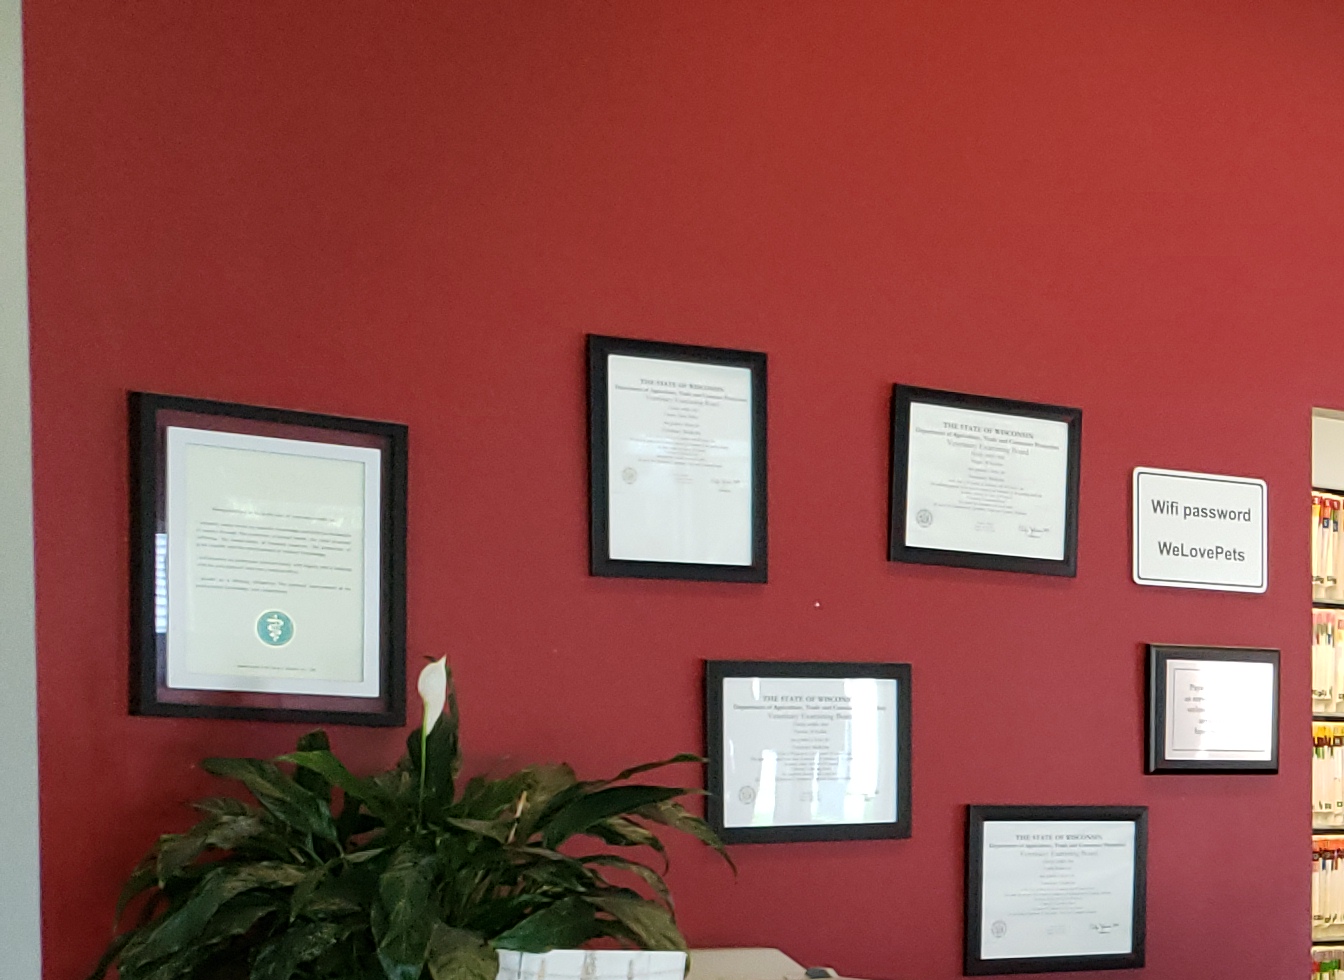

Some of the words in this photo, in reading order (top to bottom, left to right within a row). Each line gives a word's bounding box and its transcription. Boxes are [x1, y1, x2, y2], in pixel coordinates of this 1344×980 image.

[1151, 498, 1179, 516] Wifi
[1183, 503, 1252, 522] password
[1158, 540, 1246, 562] WeLovePets
